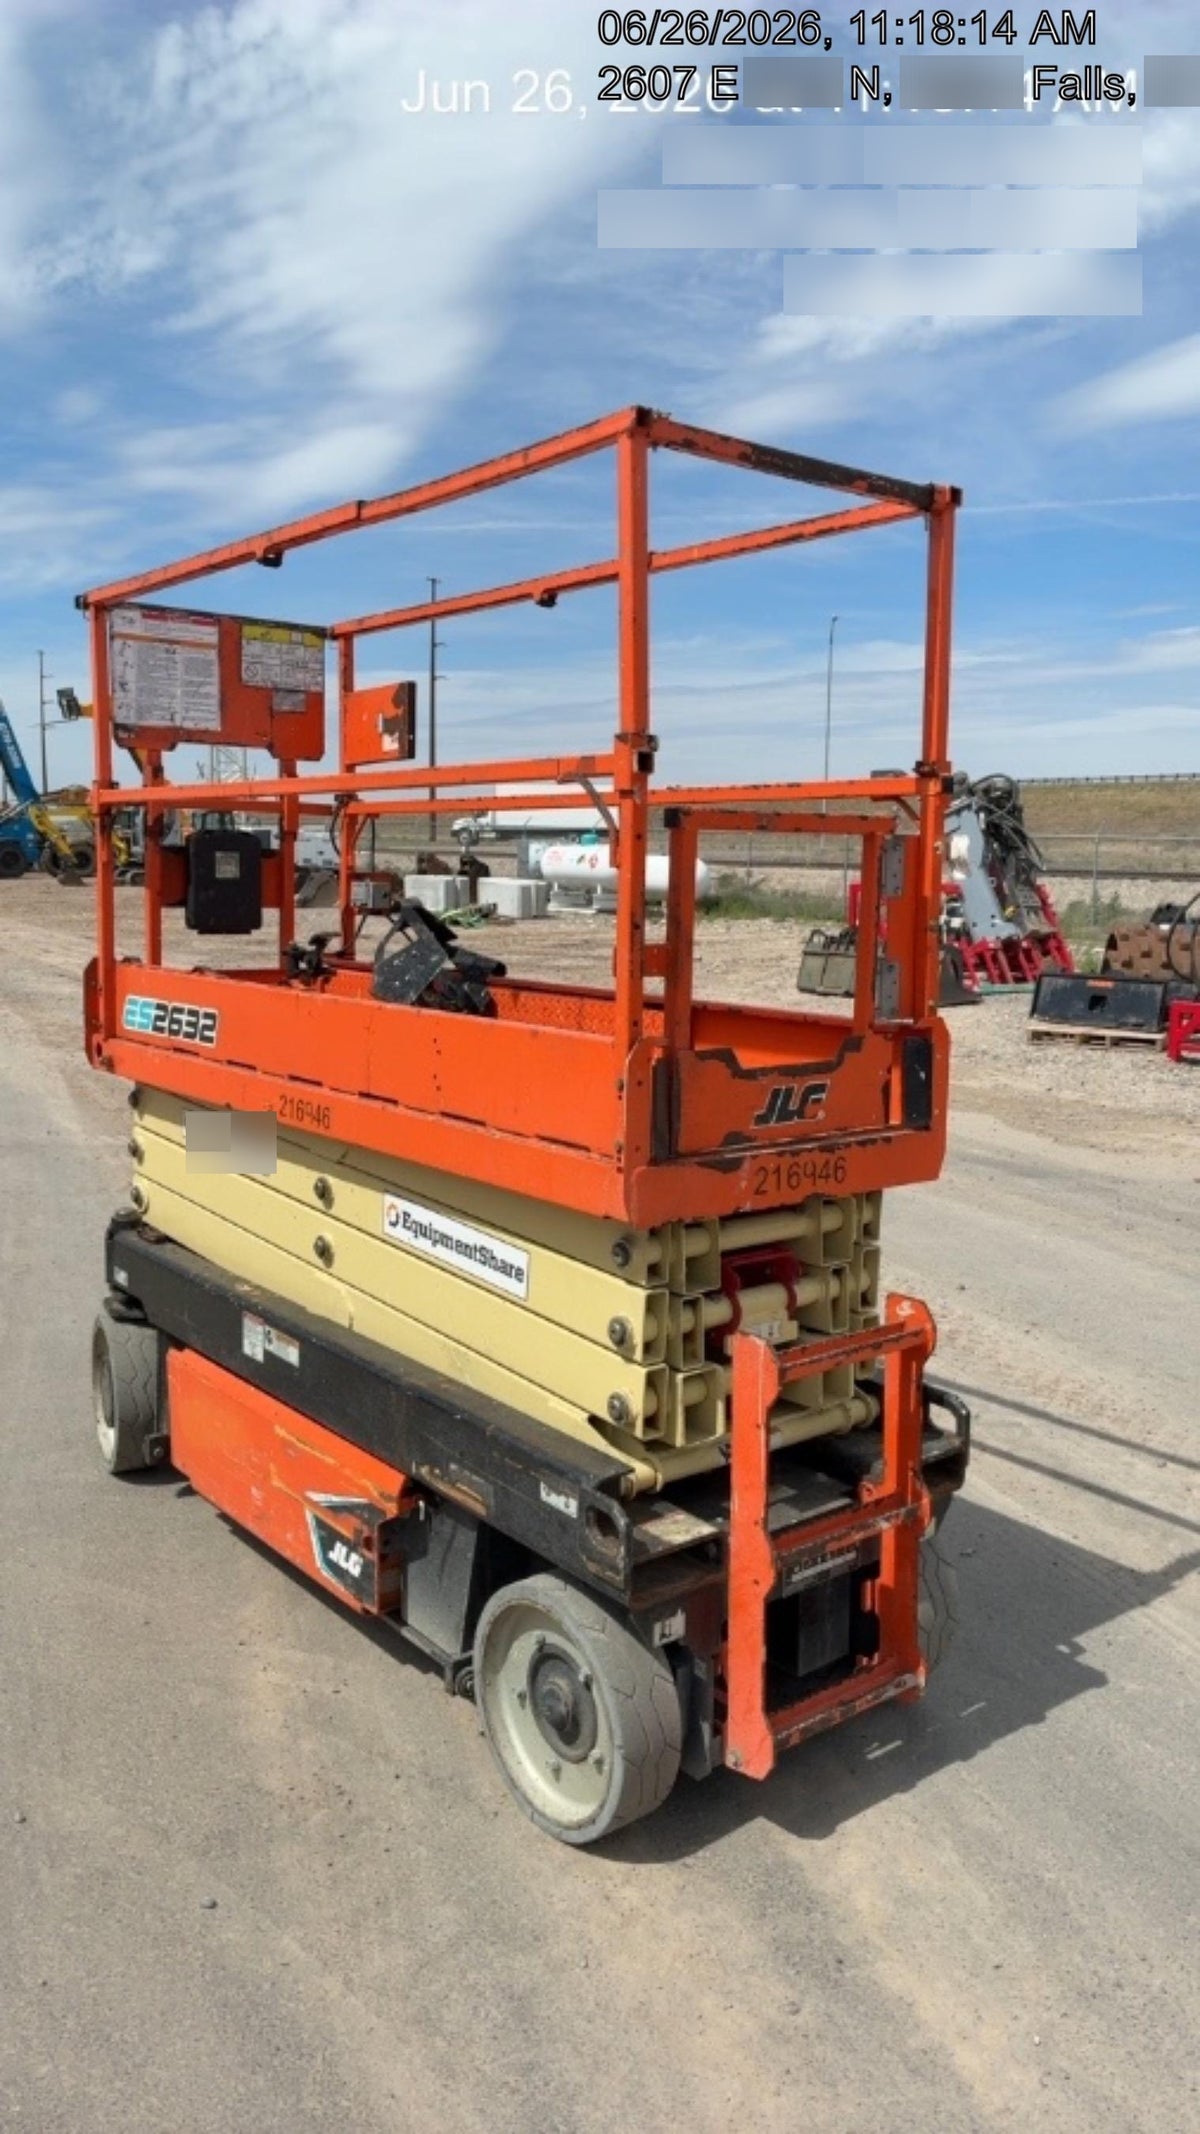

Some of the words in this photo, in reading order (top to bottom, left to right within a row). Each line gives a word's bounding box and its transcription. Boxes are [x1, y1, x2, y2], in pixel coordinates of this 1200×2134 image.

[124, 997, 219, 1045] ES2632
[279, 1093, 331, 1130] 216946
[753, 1156, 848, 1197] 216946
[401, 1210, 525, 1284] EquipmentShare
[328, 1540, 364, 1578] JLG
